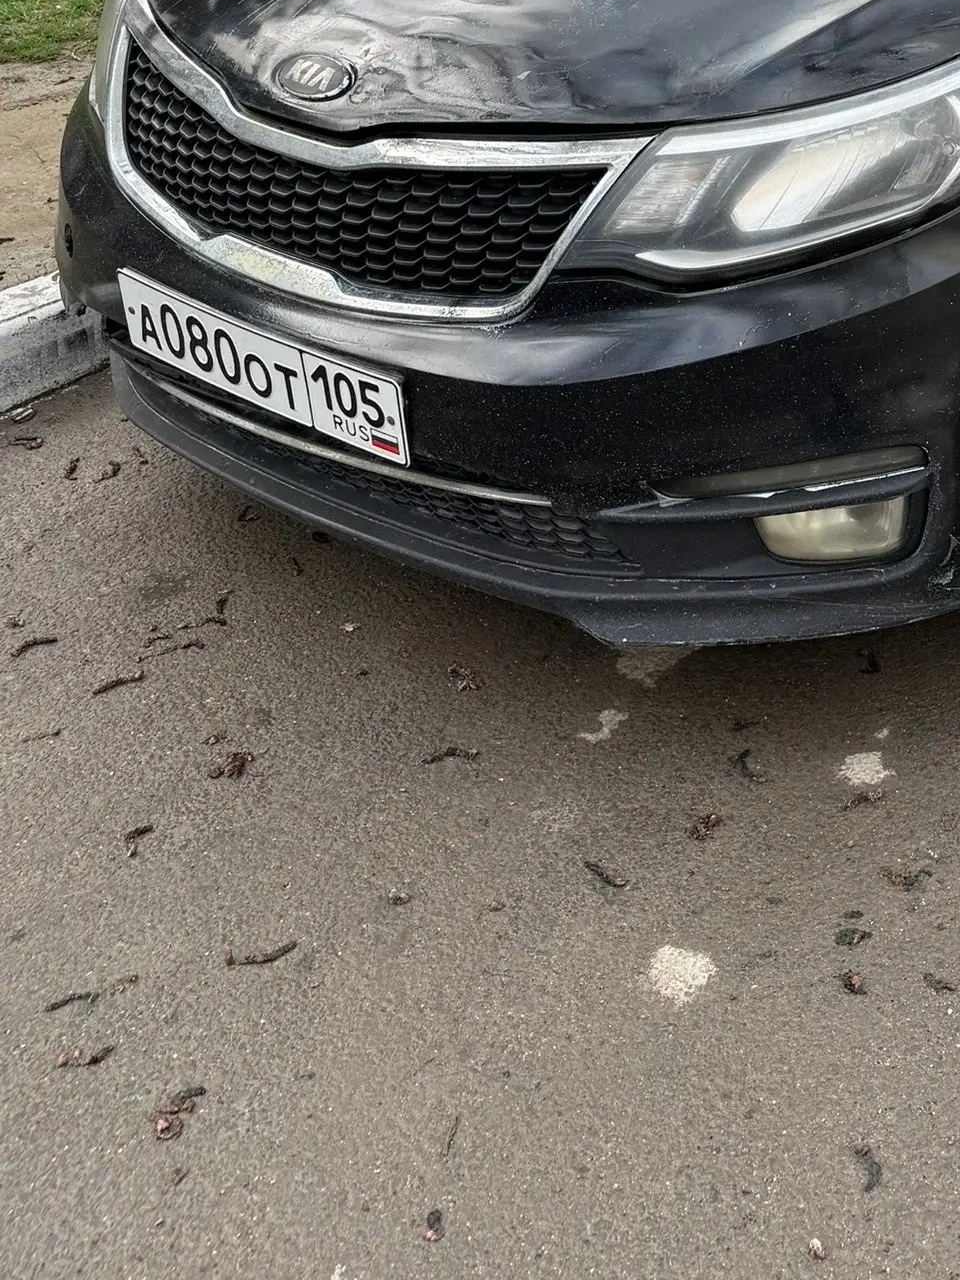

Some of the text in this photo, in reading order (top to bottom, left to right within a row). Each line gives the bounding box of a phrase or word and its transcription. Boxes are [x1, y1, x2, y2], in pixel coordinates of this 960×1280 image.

[284, 59, 336, 92] KIA
[310, 364, 386, 429] 105
[333, 415, 370, 442] RUS
